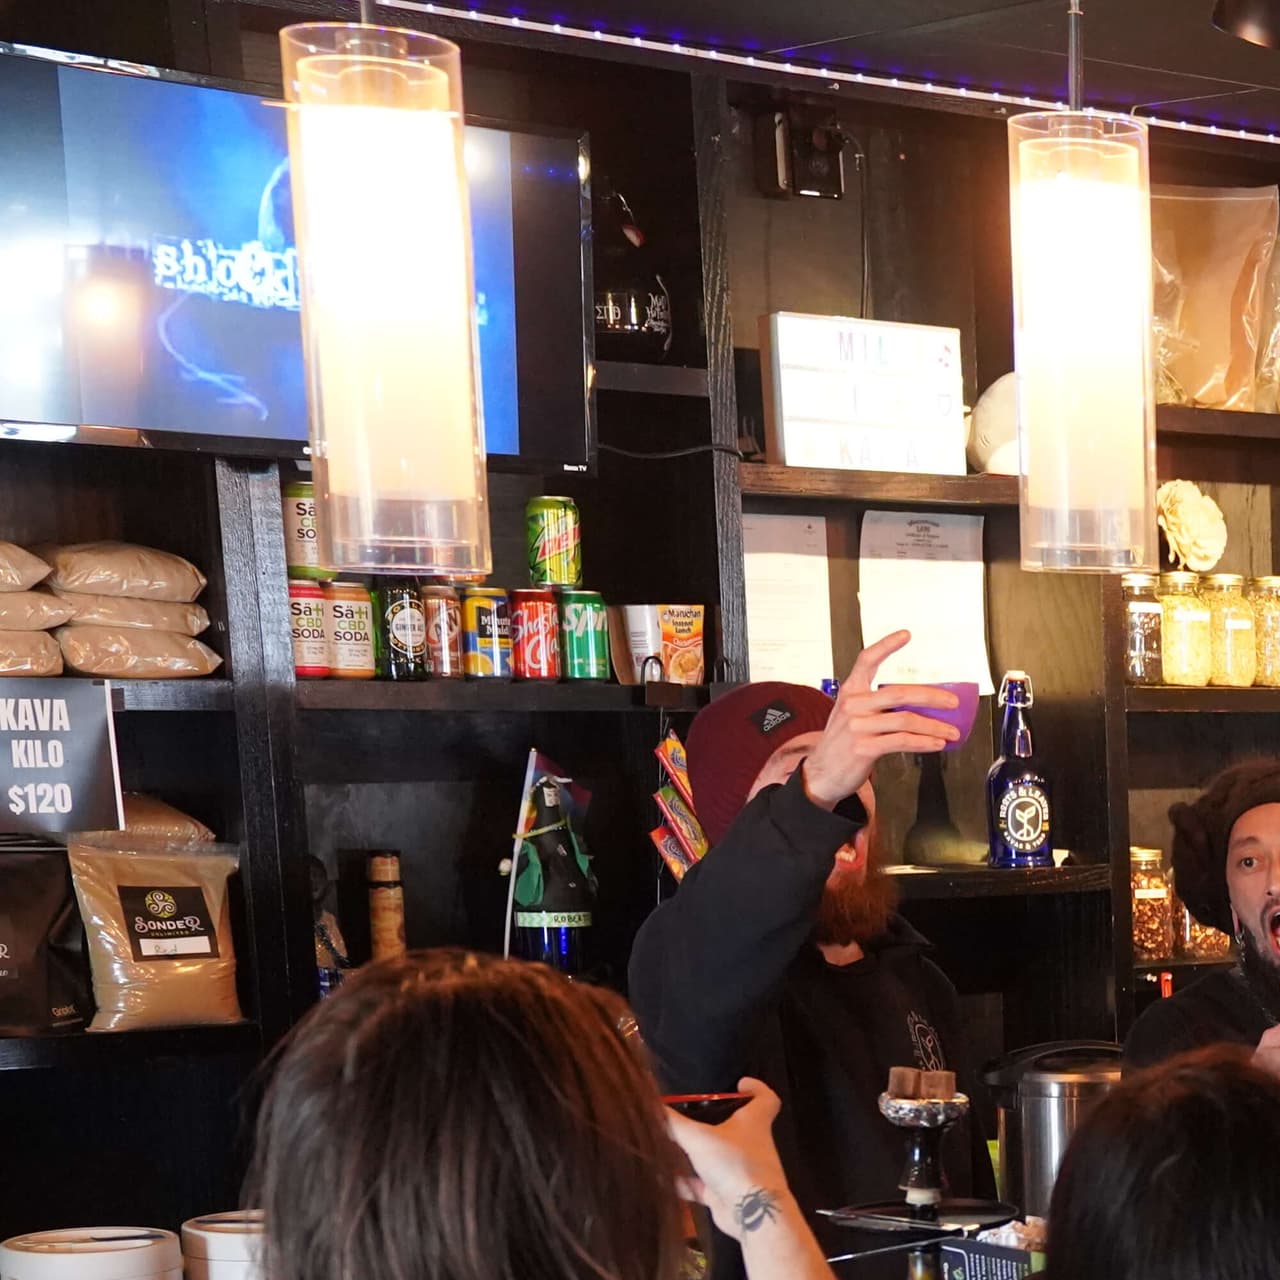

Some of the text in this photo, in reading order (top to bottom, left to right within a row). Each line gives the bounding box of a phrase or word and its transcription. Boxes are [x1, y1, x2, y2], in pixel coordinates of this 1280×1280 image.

[296, 617, 323, 628] CBD
[337, 620, 366, 631] CBD
[292, 628, 325, 639] SODA
[334, 631, 370, 642] SODA
[0, 698, 71, 731] KAVA
[11, 739, 65, 768] KILO
[8, 783, 73, 815] $120
